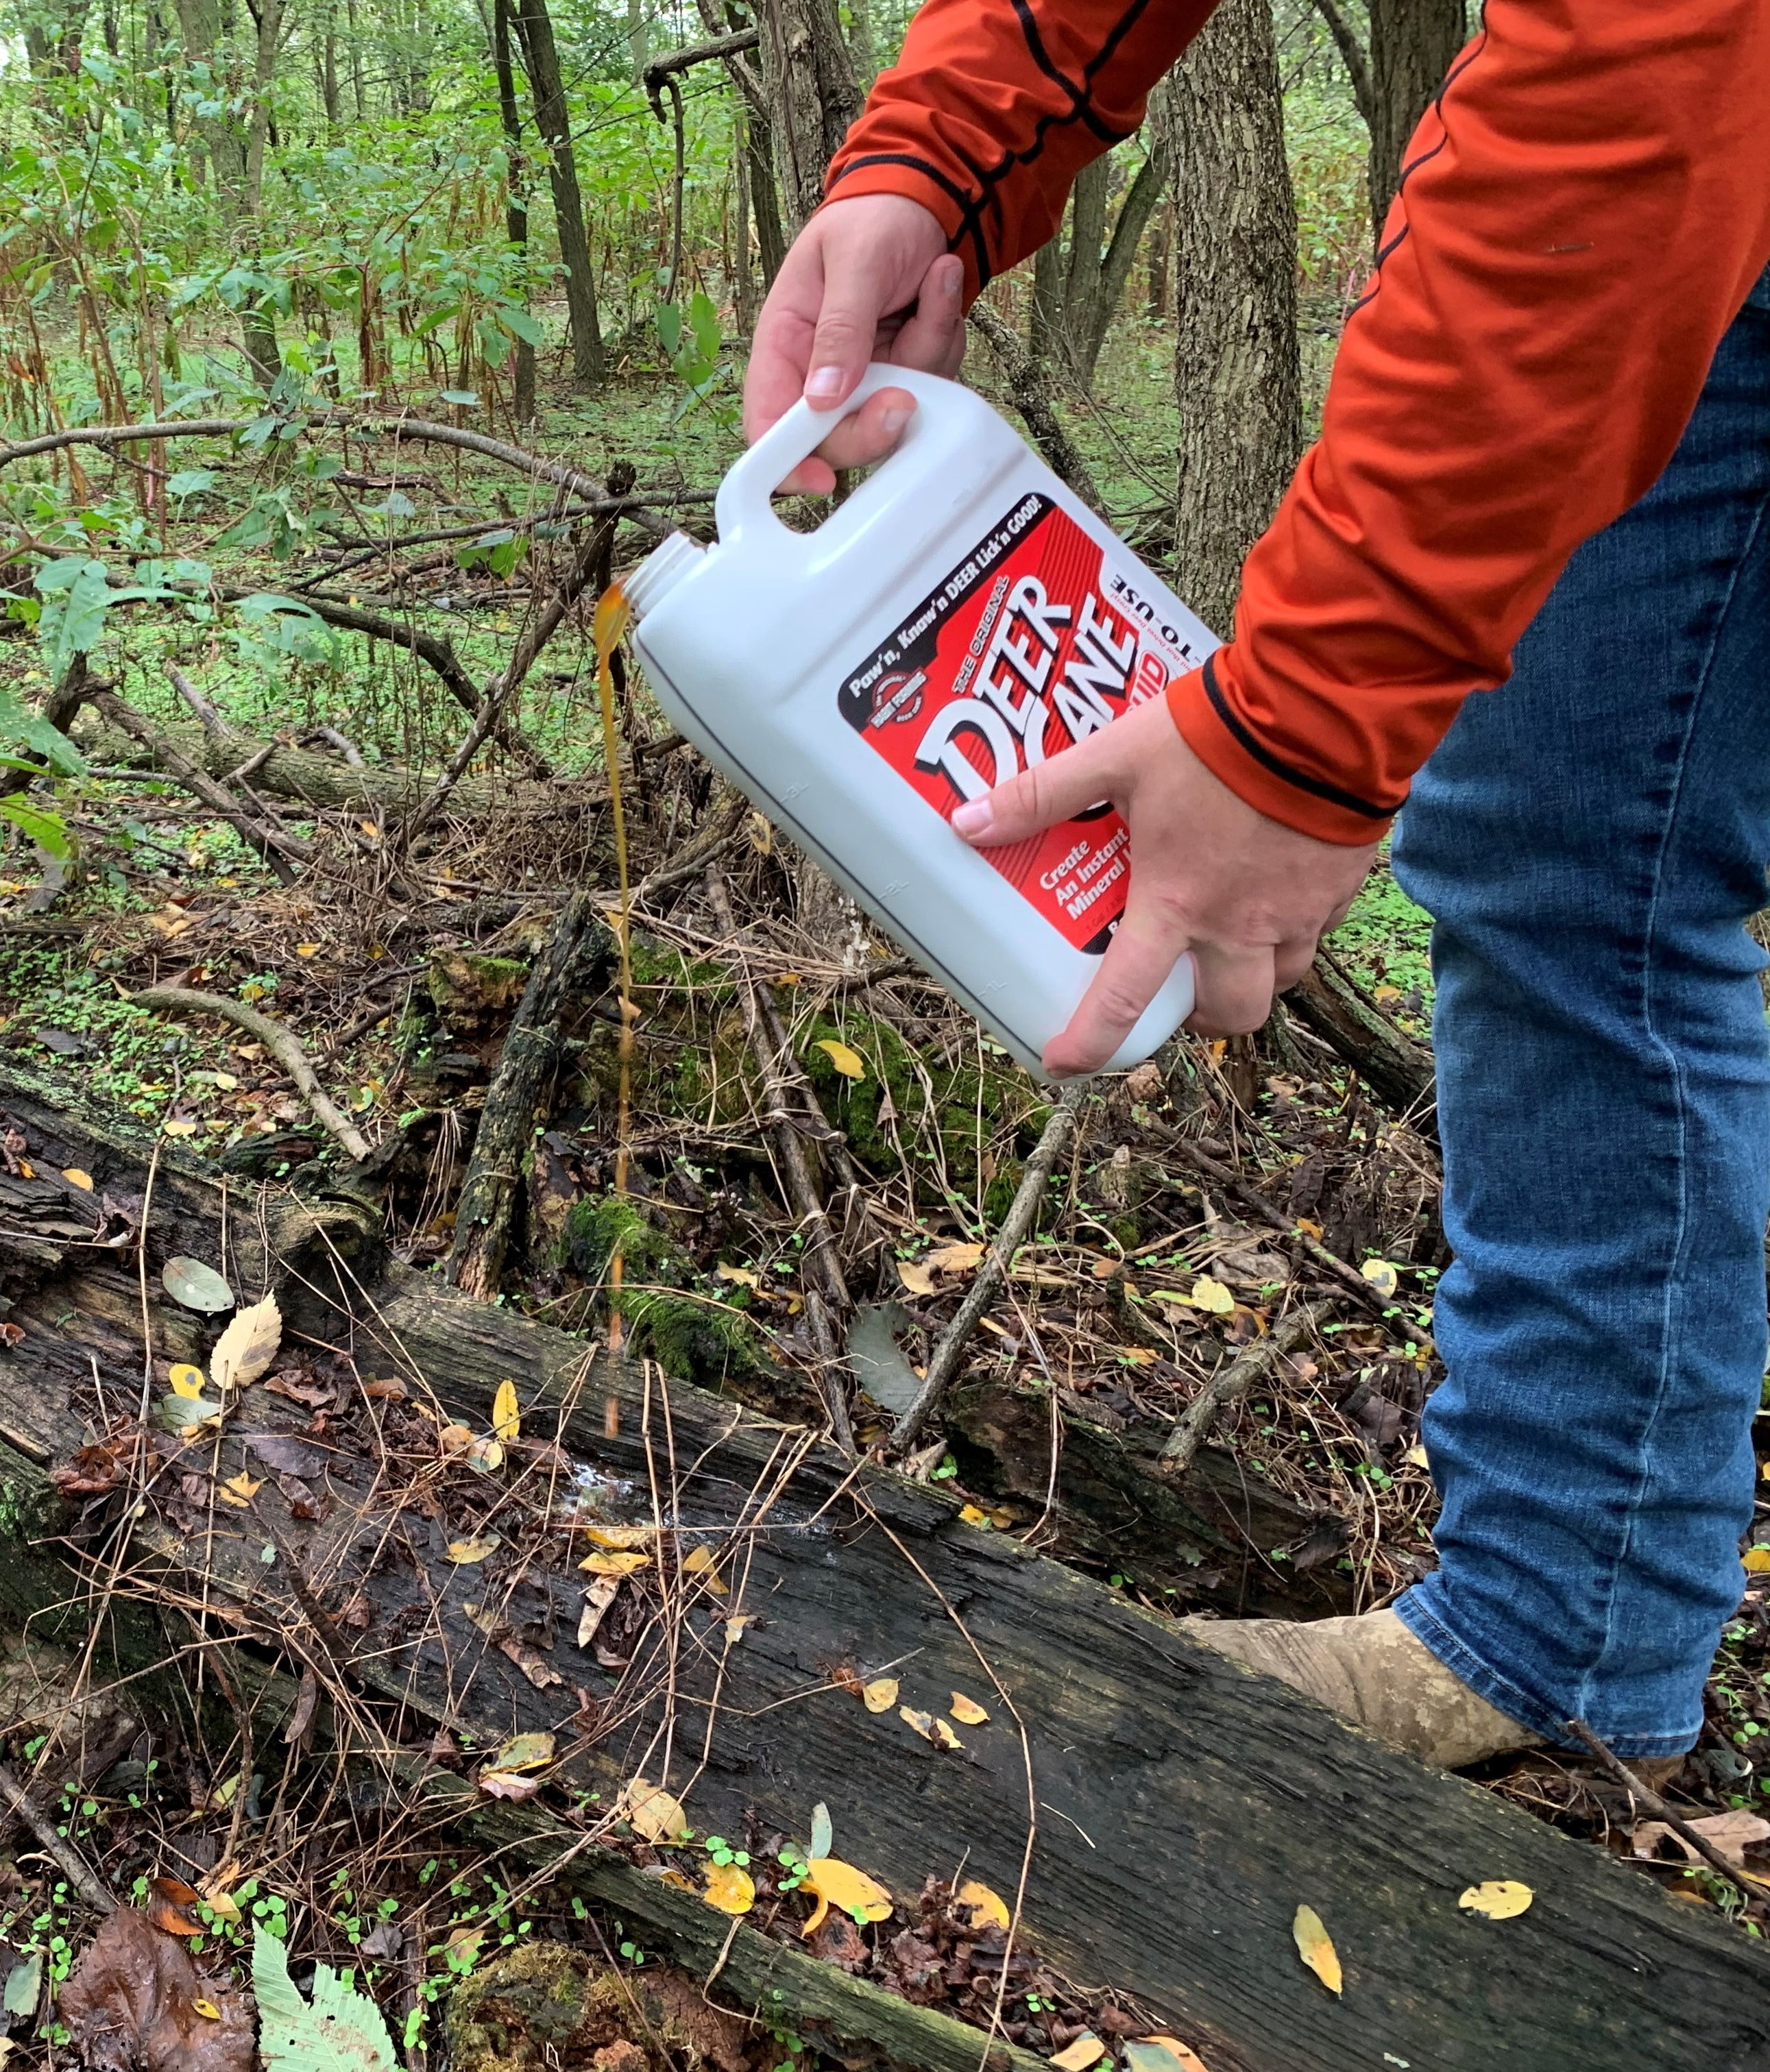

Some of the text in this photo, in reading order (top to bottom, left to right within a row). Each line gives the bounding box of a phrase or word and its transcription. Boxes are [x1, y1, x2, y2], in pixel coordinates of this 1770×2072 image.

[849, 650, 900, 697] Paw'n,
[897, 596, 948, 649] Knaw'n
[945, 562, 980, 600] DEER
[975, 532, 1010, 568] Lick'n
[1008, 495, 1041, 534] GOOD!
[951, 575, 1009, 693] THE ORIGINAL
[913, 576, 1071, 801] DEER
[1029, 592, 1139, 810] CANE
[1040, 842, 1089, 890] Create
[1056, 881, 1078, 907] An
[1076, 828, 1128, 883] Instant
[1066, 857, 1124, 920] Mineral
